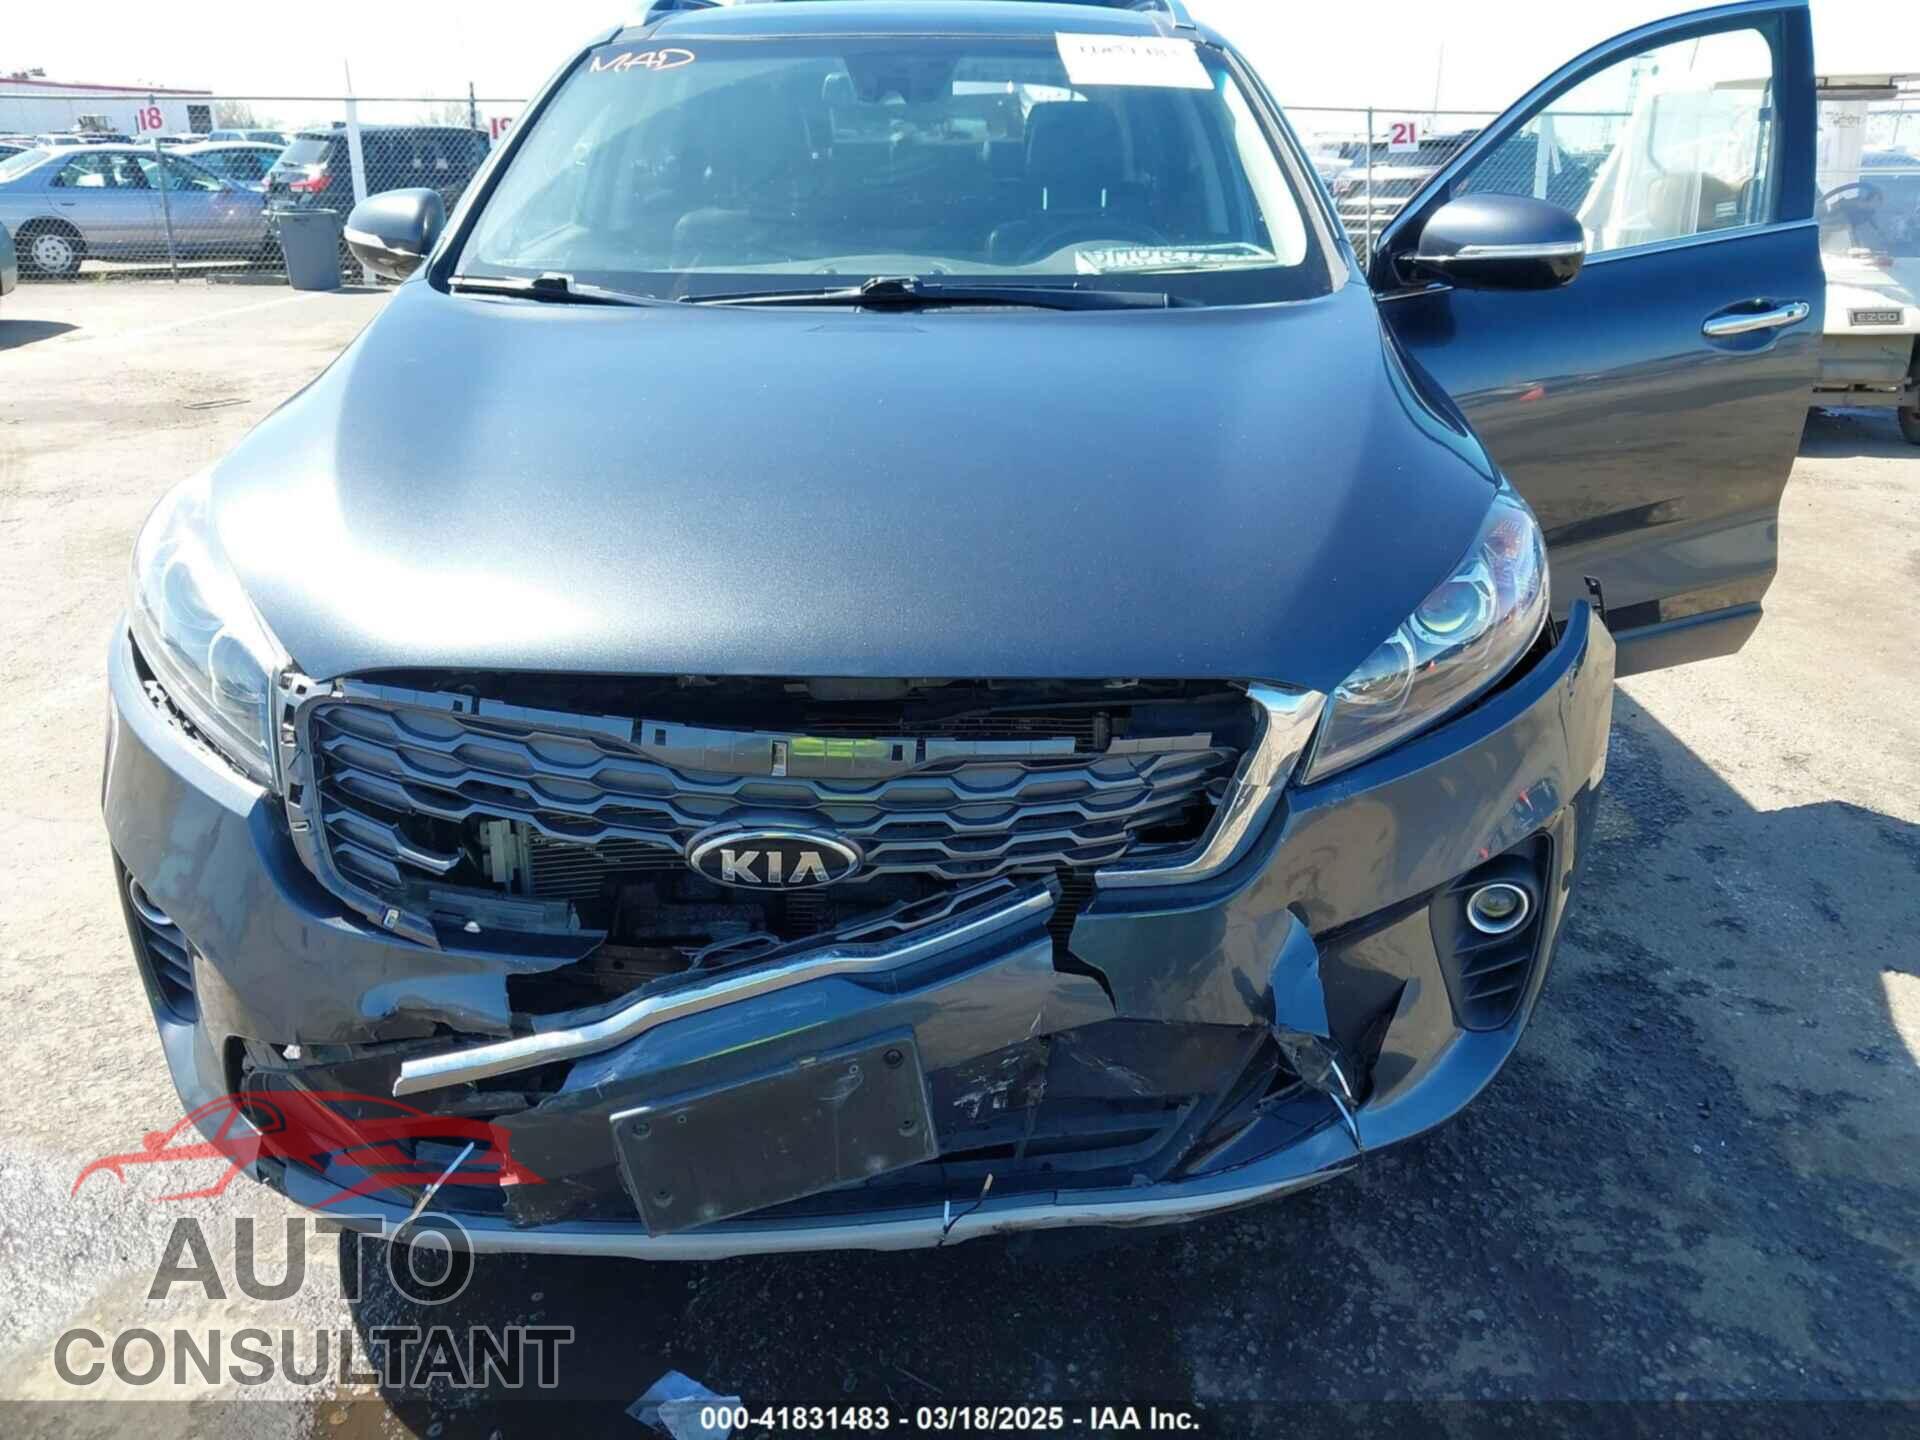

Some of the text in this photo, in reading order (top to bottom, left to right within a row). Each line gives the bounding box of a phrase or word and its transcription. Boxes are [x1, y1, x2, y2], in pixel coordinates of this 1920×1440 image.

[139, 107, 163, 130] 18
[1391, 123, 1415, 144] 21
[719, 849, 830, 884] KIA
